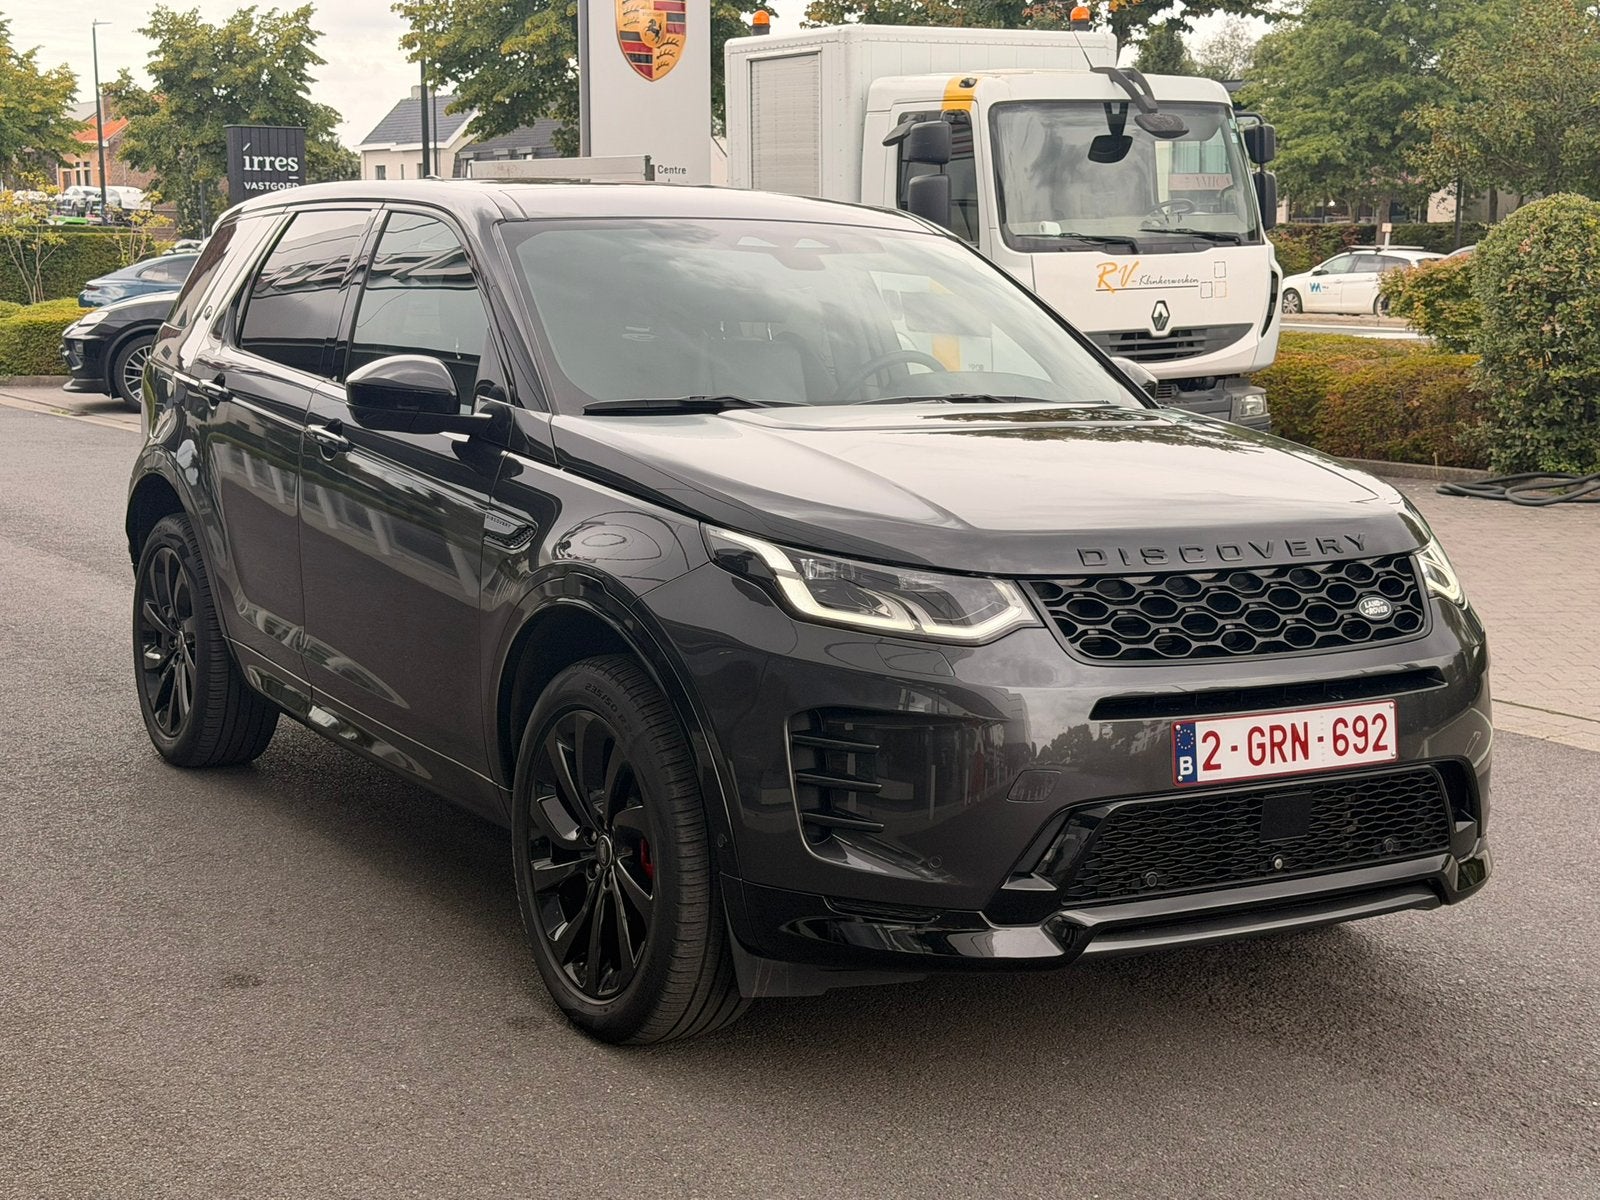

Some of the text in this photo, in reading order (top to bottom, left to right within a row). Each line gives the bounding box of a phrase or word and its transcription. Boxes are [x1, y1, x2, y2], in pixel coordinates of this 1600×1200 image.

[657, 164, 687, 175] Centre
[1077, 533, 1366, 567] DISCOVERY
[584, 682, 618, 713] 235/50
[1179, 713, 1389, 775] B 2-GRN-692
